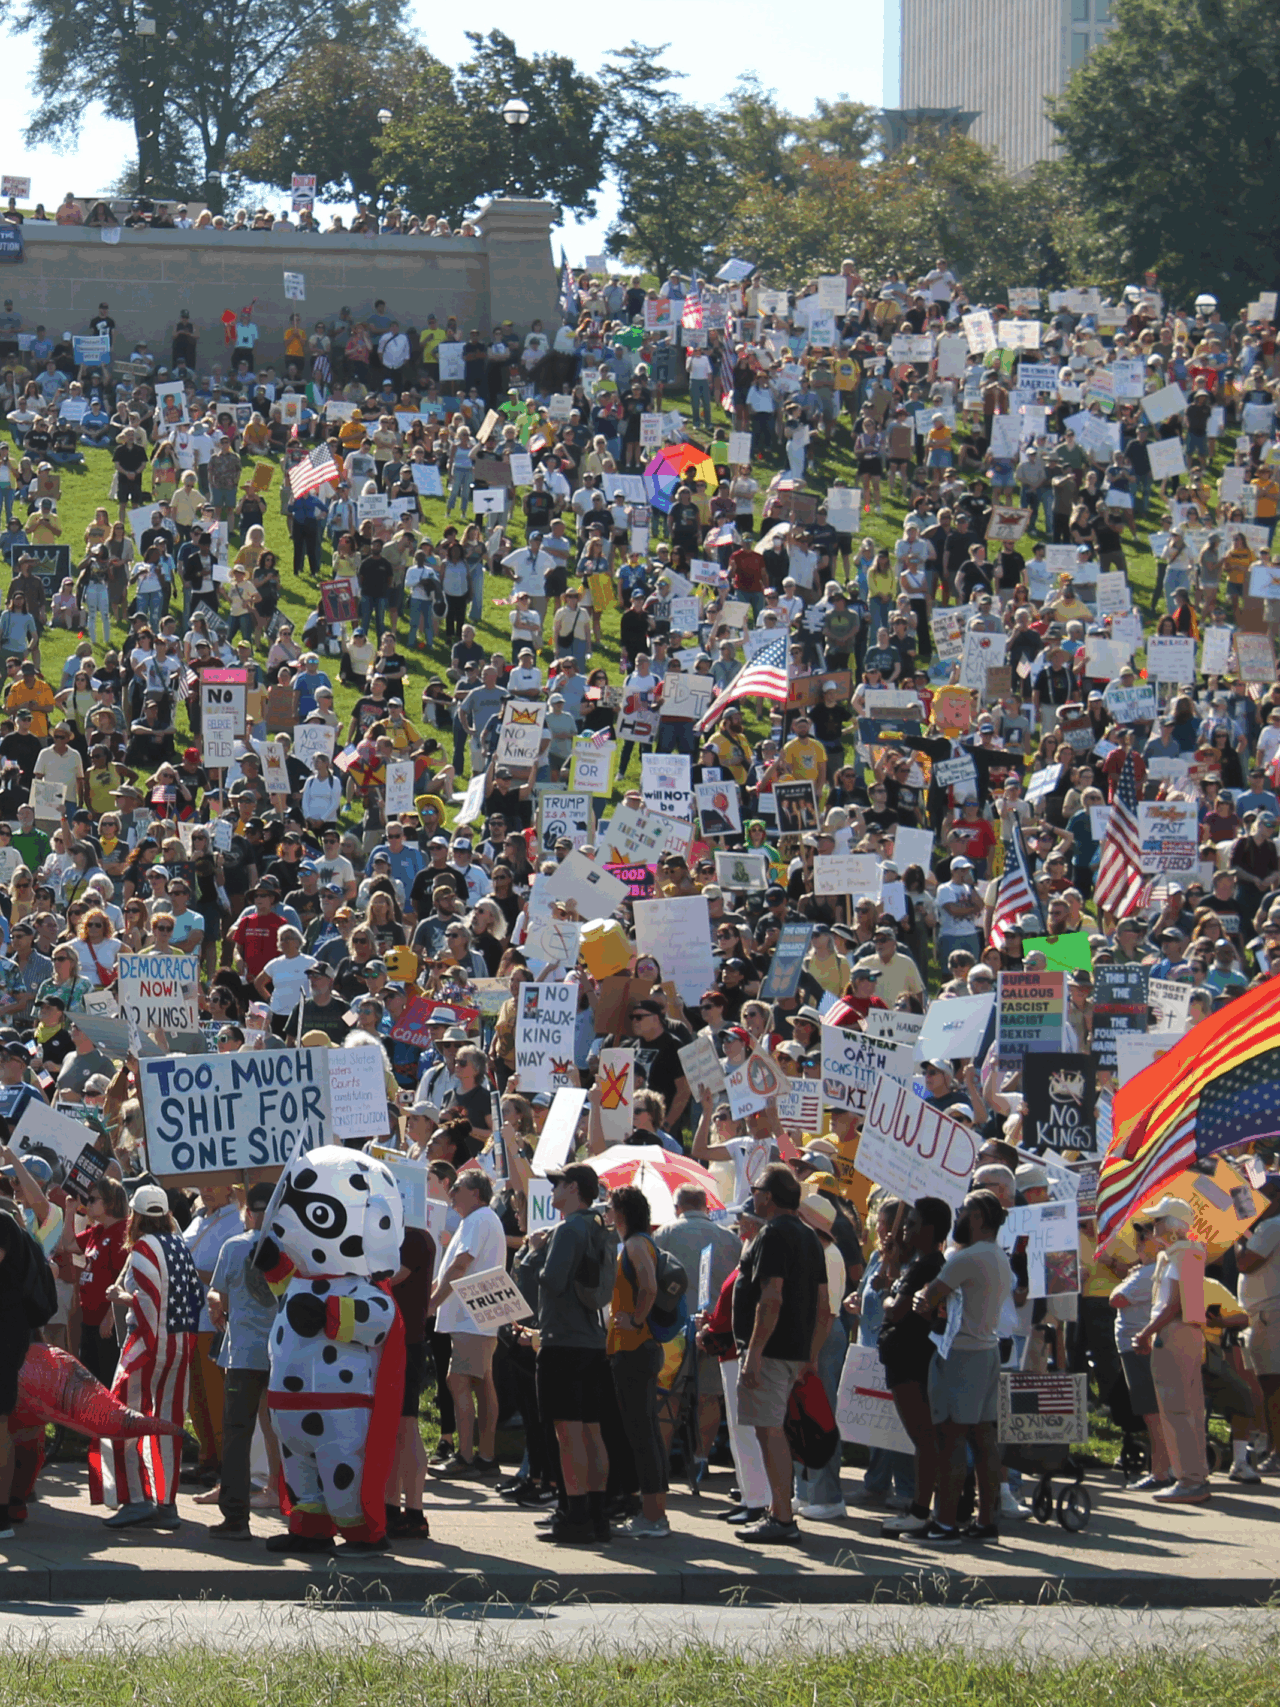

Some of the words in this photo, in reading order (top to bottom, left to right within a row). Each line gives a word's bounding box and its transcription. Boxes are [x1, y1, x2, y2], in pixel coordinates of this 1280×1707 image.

[208, 688, 233, 703] NO
[300, 729, 318, 740] NO
[504, 728, 526, 740] NO
[207, 741, 233, 758] FILES
[579, 765, 599, 778] OR
[644, 791, 663, 800] will
[664, 791, 691, 800] NOT
[699, 785, 730, 797] RESIST
[544, 797, 585, 809] TRUMP
[660, 801, 675, 811] be
[120, 957, 199, 982] DEMOCRACY
[1002, 974, 1041, 985] SUPER
[1105, 973, 1125, 984] THIS
[1127, 973, 1137, 984] IS
[140, 981, 178, 998] NOW!
[545, 986, 569, 1002] NO
[1001, 987, 1055, 998] CALLOUS
[1112, 987, 1130, 998] THE
[1149, 982, 1188, 994] FORGET
[1161, 992, 1185, 1002] 2021
[1001, 1001, 1050, 1012] FASCIST
[535, 1009, 575, 1026] FAUX-
[872, 1012, 897, 1023] TINY
[1000, 1014, 1045, 1025] RACIST
[1110, 1017, 1128, 1028] THE
[522, 1028, 562, 1044] KING
[1000, 1028, 1042, 1039] SEXIST
[860, 1034, 898, 1052] SWEAR
[999, 1043, 1029, 1054] NAZI
[349, 1052, 376, 1064] States
[517, 1052, 545, 1067] WAY
[843, 1047, 887, 1070] OATH
[999, 1058, 1023, 1070] POT
[231, 1049, 313, 1090] MUCH
[331, 1076, 361, 1089] Courts
[553, 1075, 569, 1085] NO
[334, 1091, 373, 1101] onstitution
[260, 1086, 326, 1126] FOR
[1049, 1104, 1079, 1127] NO
[870, 1074, 976, 1178] WWJD
[1036, 1121, 1092, 1149] KINGS
[171, 1137, 238, 1171] ONE
[532, 1195, 556, 1221] NO
[1190, 1192, 1209, 1215] THE
[458, 1275, 507, 1299] FIGHT
[466, 1287, 516, 1311] TRUTH
[473, 1300, 523, 1324] DECAY
[1008, 1416, 1025, 1433] NO
